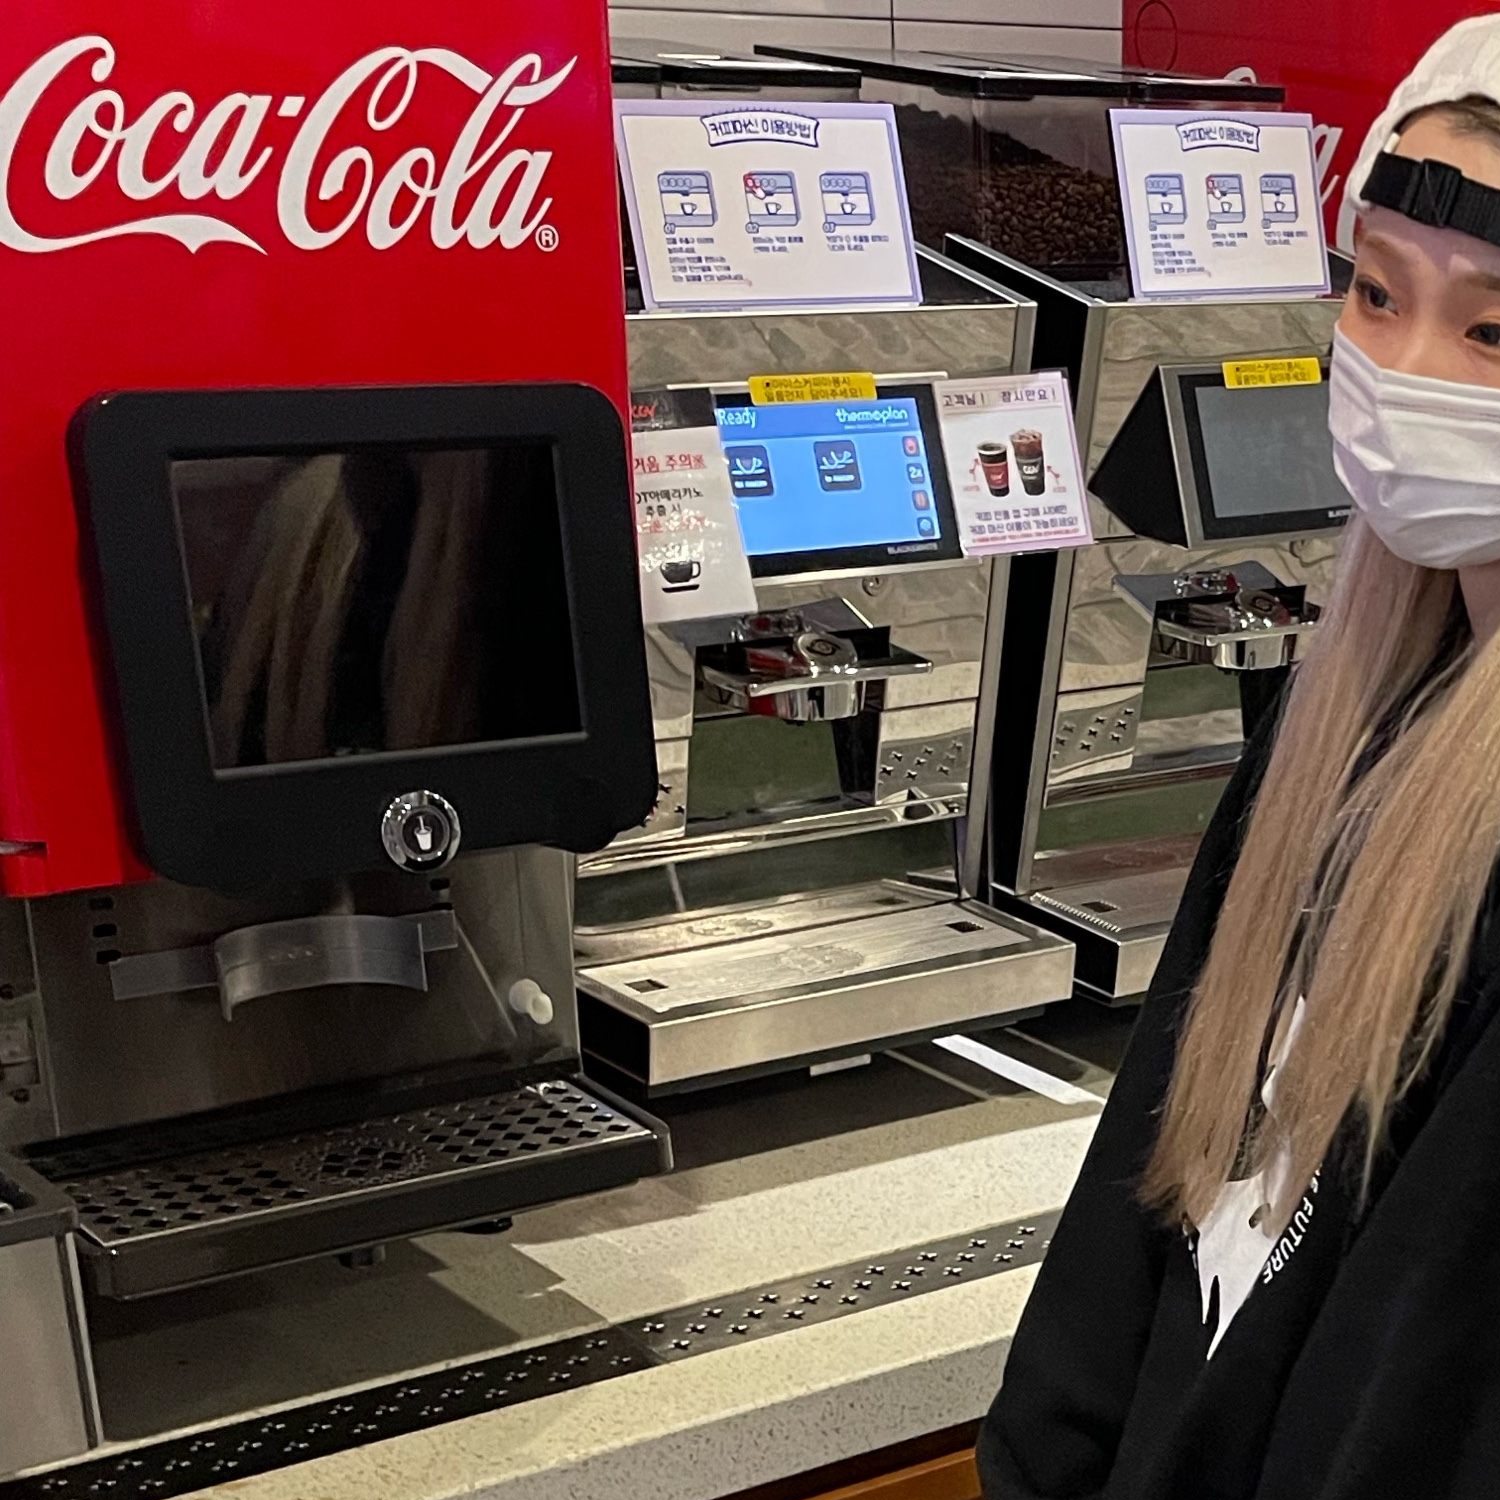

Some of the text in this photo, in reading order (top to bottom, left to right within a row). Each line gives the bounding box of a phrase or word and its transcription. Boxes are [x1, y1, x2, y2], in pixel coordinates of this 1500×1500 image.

[709, 118, 811, 139] 커피머신 이용방법
[0, 35, 577, 255] Coca-Cola
[718, 407, 757, 428] Ready
[836, 406, 908, 424] thermoplan
[634, 455, 660, 474] 거움
[1263, 1197, 1314, 1284] FUTURE
